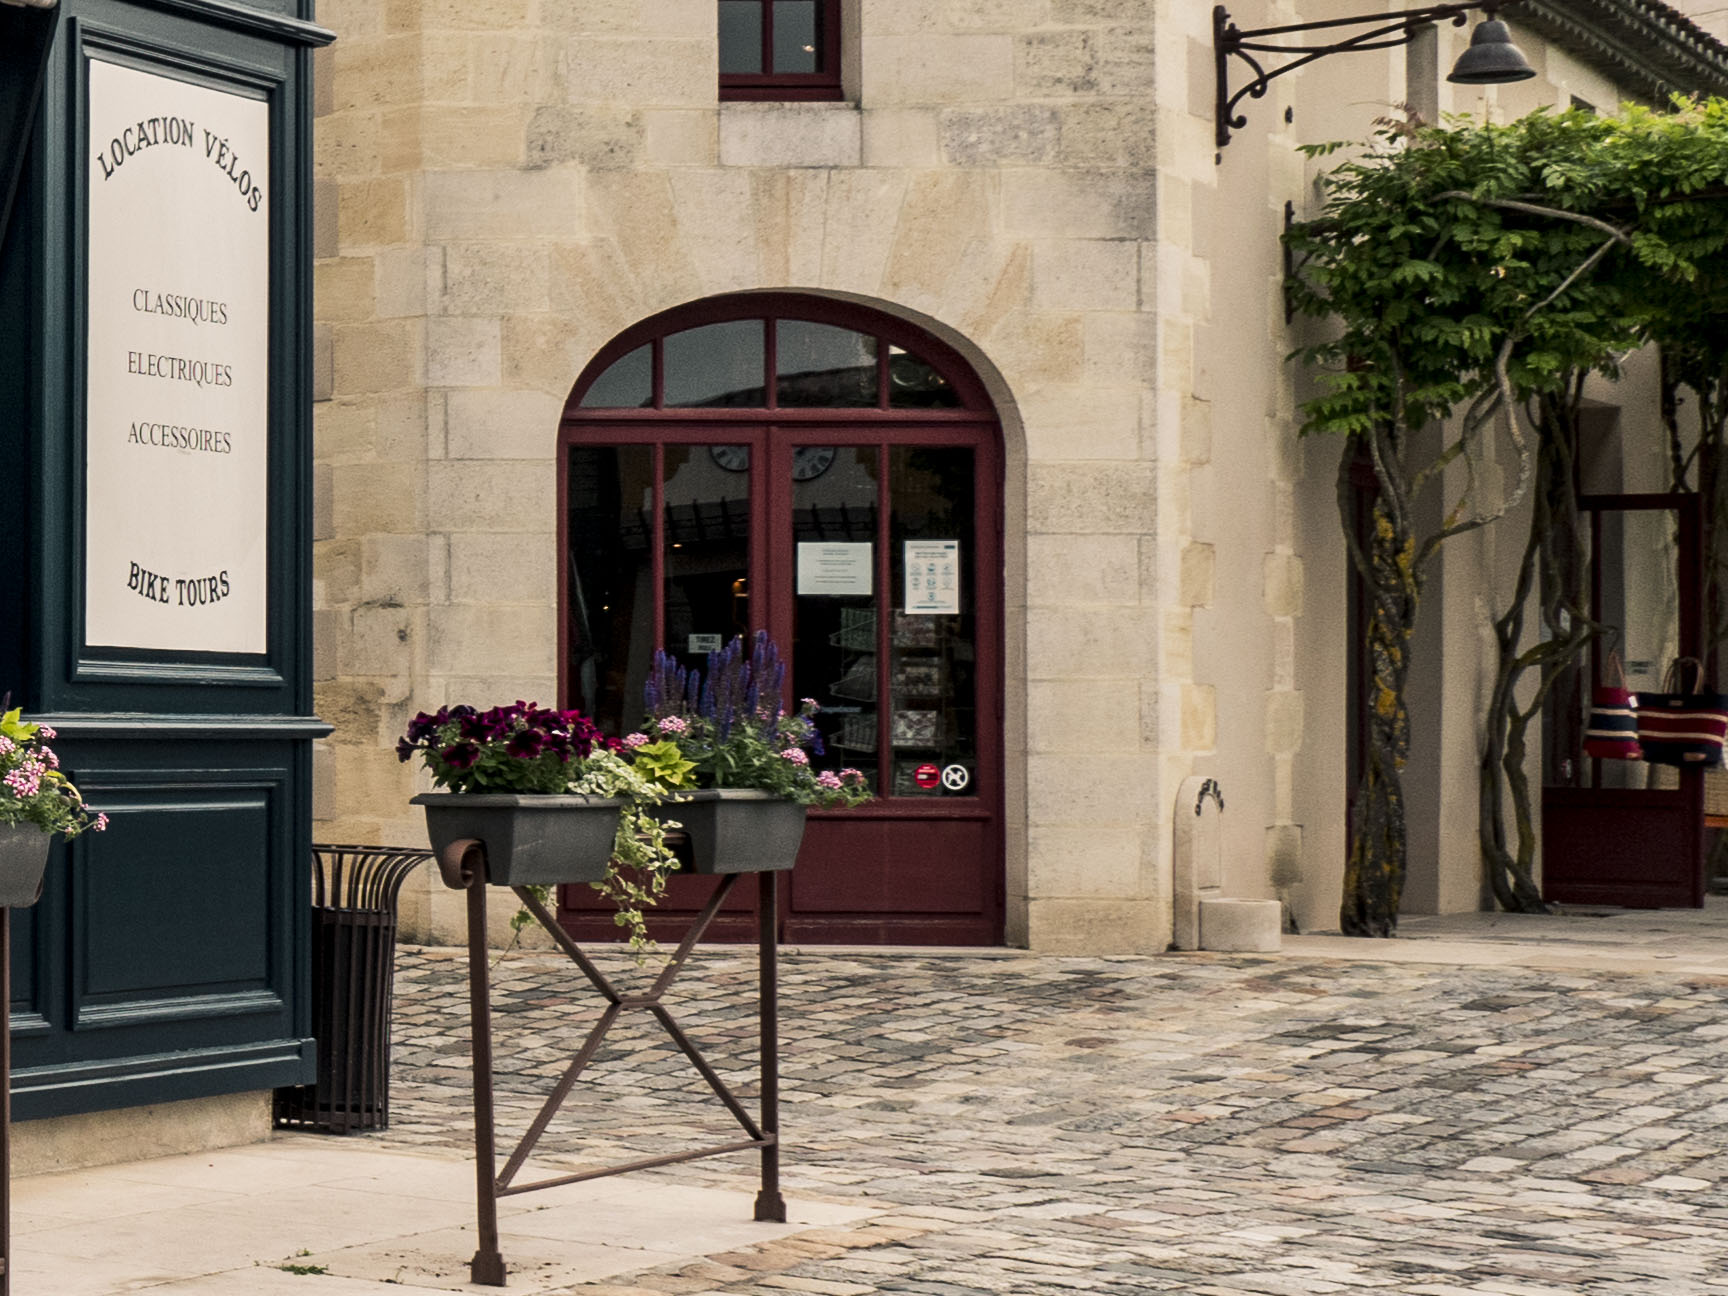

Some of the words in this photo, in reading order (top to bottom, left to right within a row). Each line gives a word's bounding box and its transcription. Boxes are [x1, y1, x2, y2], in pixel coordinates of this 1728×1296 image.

[97, 116, 195, 181] LOCATION
[203, 129, 263, 214] VÉLOS
[132, 288, 228, 326] CLASSIQUES
[127, 351, 233, 388] ELECTRIQUES
[127, 422, 232, 454] ACCESSOIRES
[126, 560, 171, 605] BIKE
[175, 570, 231, 607] TOURS
